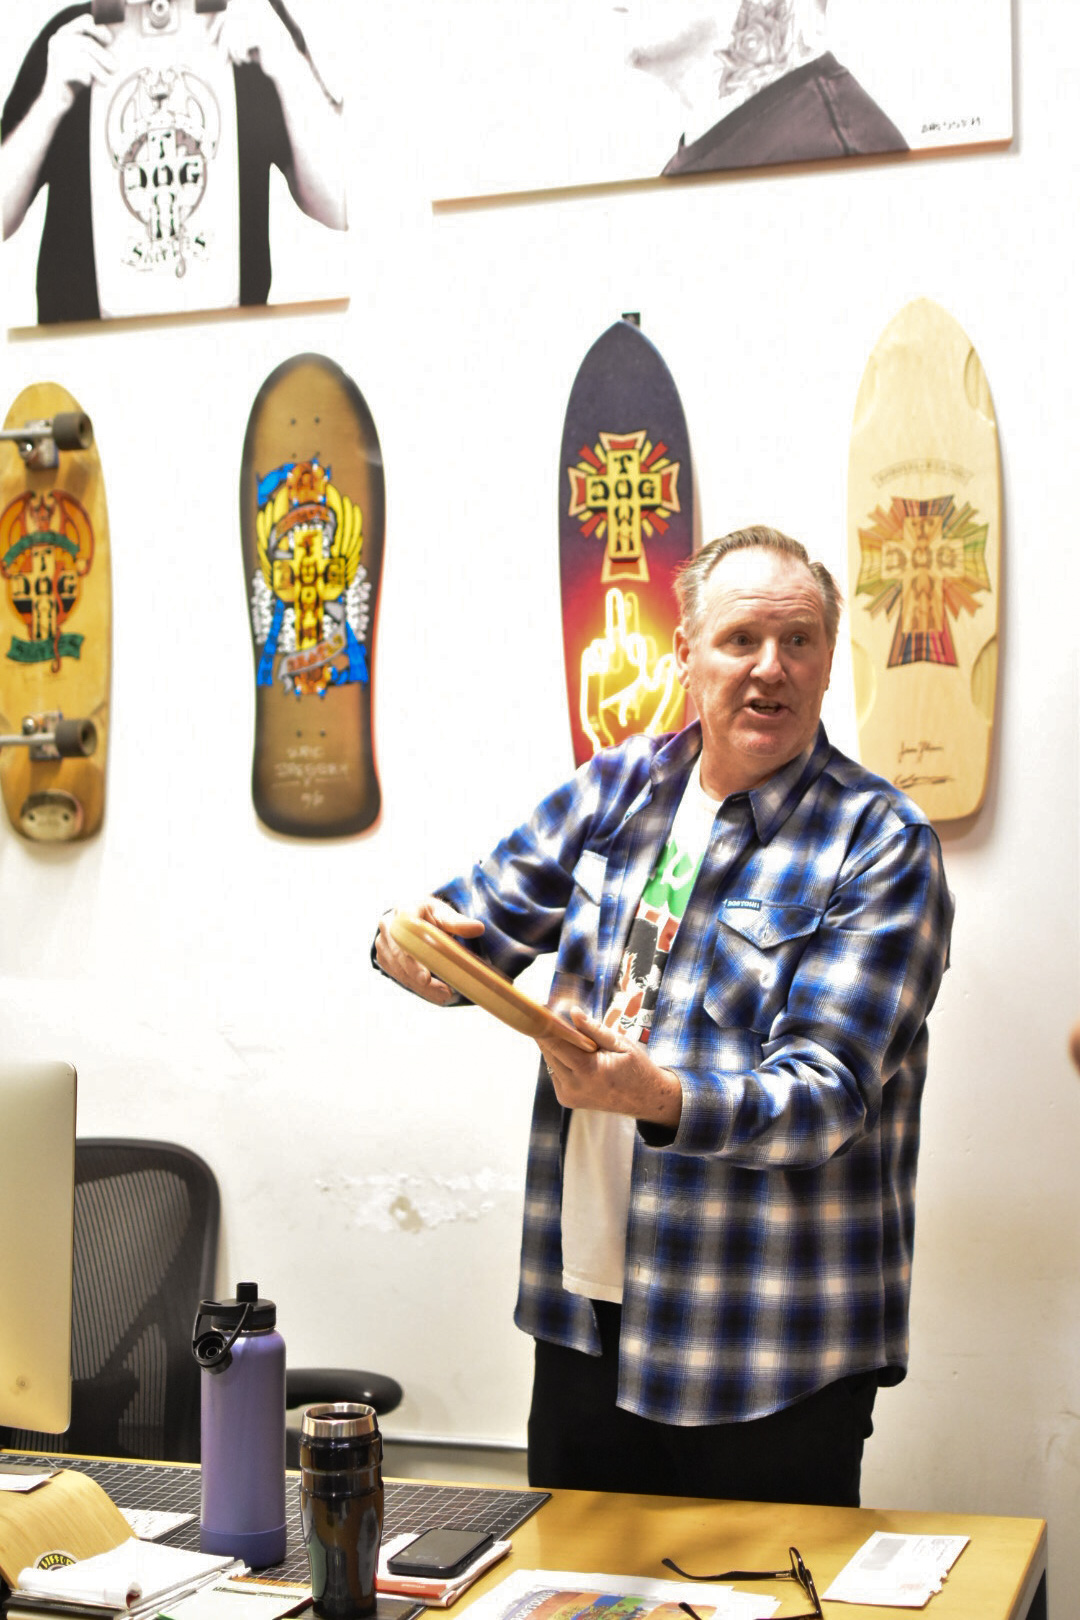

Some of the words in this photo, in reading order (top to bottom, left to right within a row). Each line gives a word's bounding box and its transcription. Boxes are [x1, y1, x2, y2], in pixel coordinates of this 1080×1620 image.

[591, 478, 656, 502] DOG
[614, 454, 635, 552] TOWN
[885, 545, 957, 572] DOG
